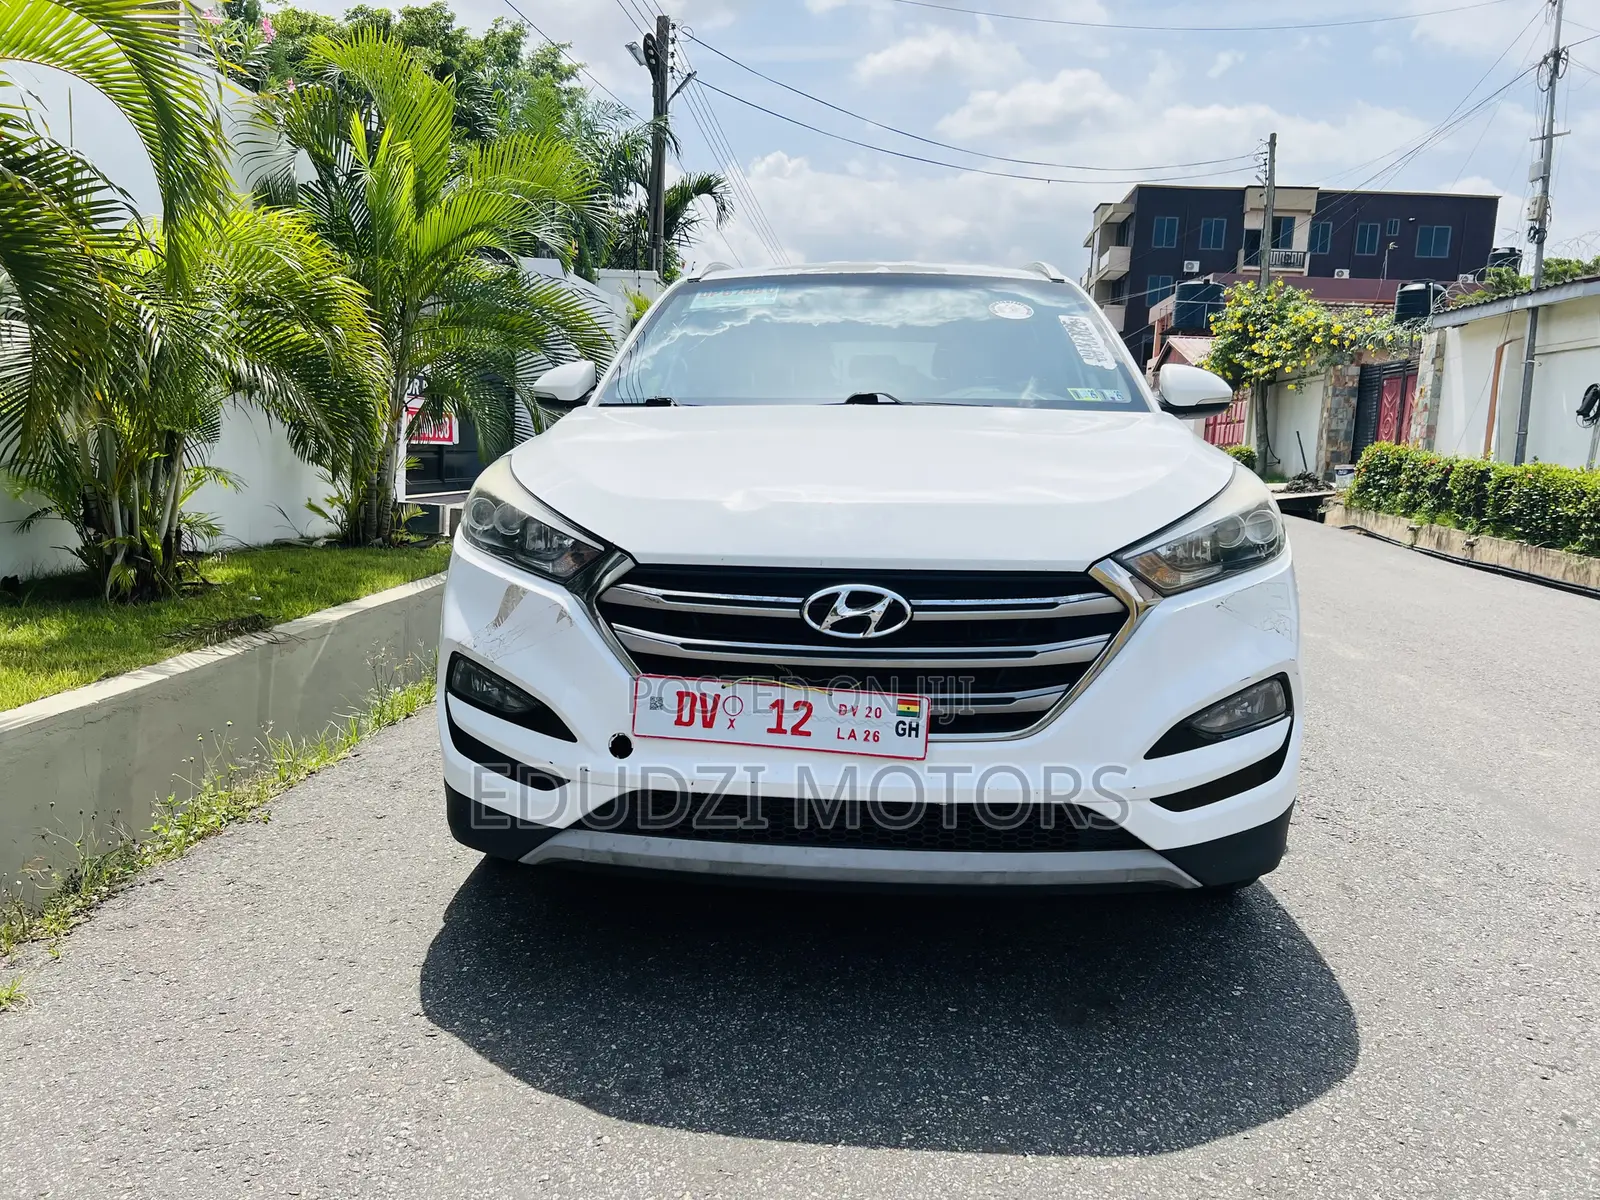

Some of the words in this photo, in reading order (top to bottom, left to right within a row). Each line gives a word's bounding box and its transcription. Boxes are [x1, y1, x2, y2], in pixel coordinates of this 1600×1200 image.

[674, 690, 721, 729] DV
[766, 698, 814, 737] 12
[838, 703, 859, 717] DV
[865, 706, 883, 719] 20
[836, 727, 858, 741] LA
[863, 729, 880, 742] 26
[895, 720, 920, 738] GH
